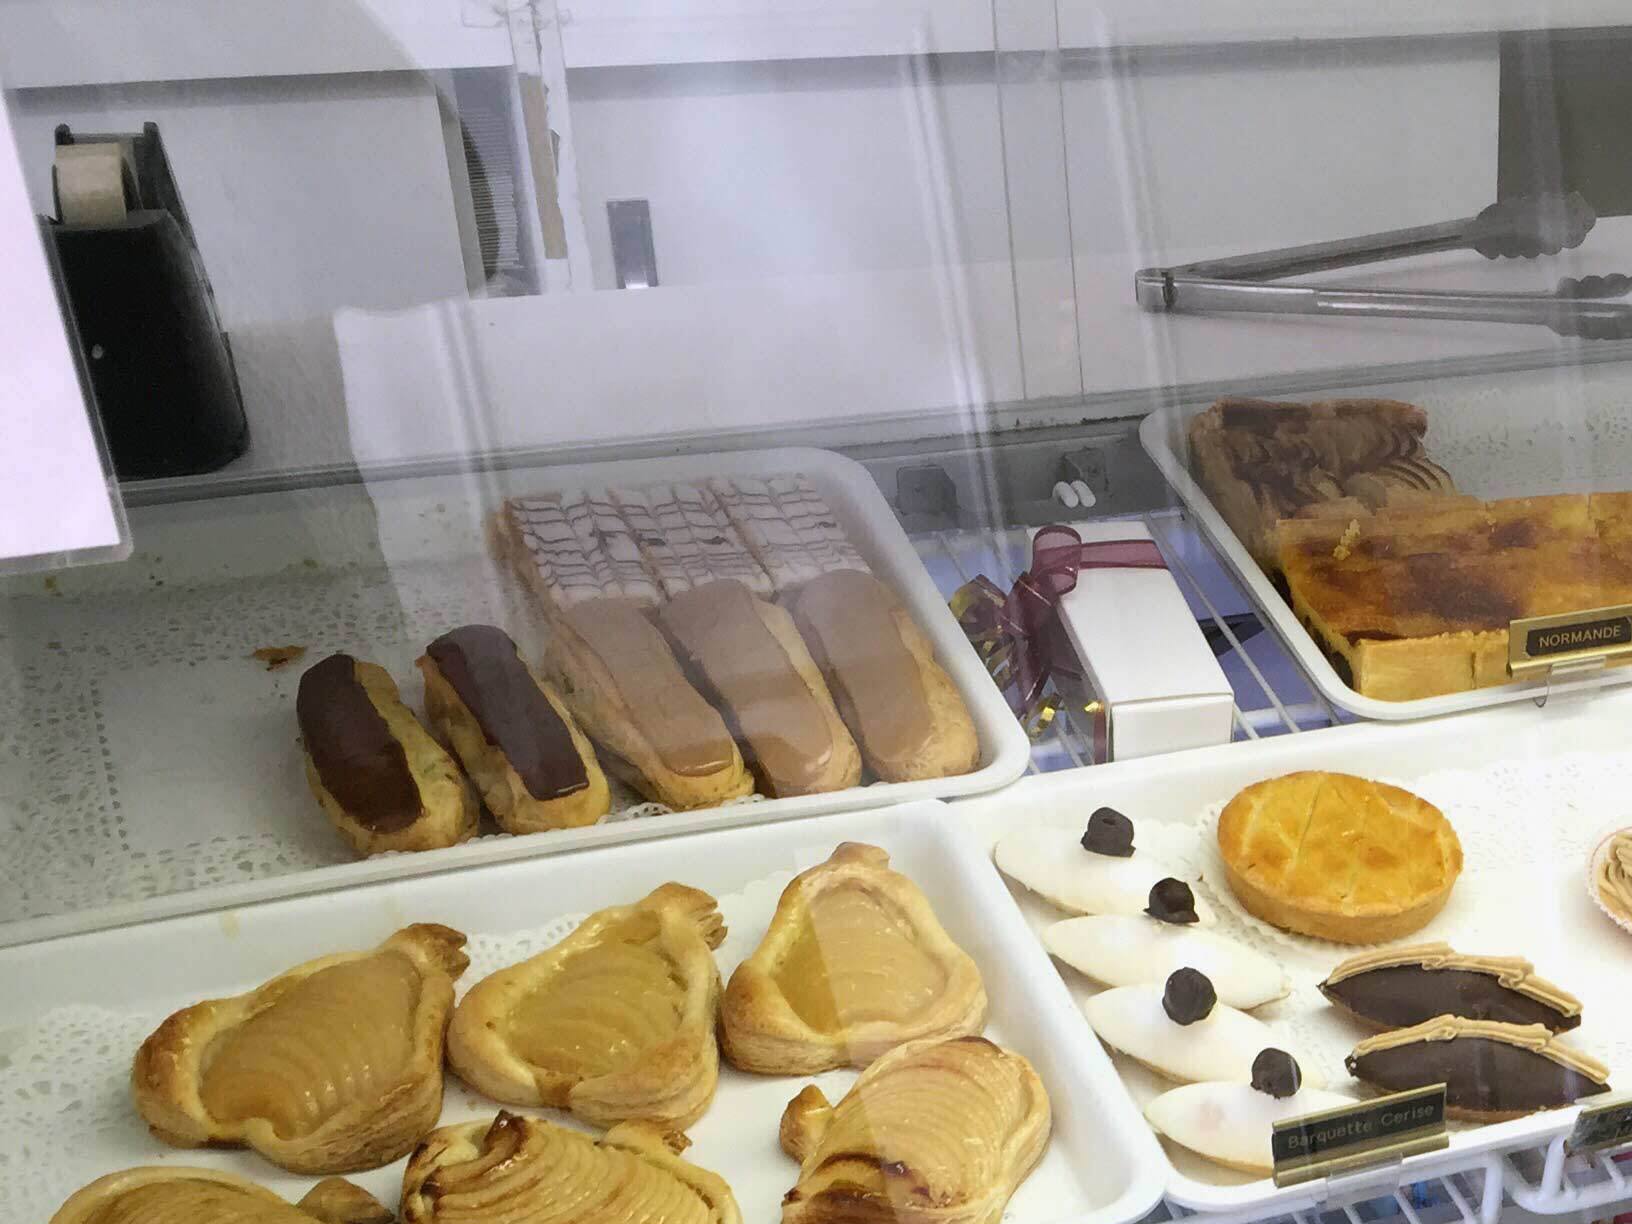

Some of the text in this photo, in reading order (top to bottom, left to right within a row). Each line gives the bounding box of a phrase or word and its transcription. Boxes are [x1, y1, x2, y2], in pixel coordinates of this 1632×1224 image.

[1538, 624, 1622, 648] NORMANDE
[1287, 1103, 1435, 1149] Barquette Cerise
